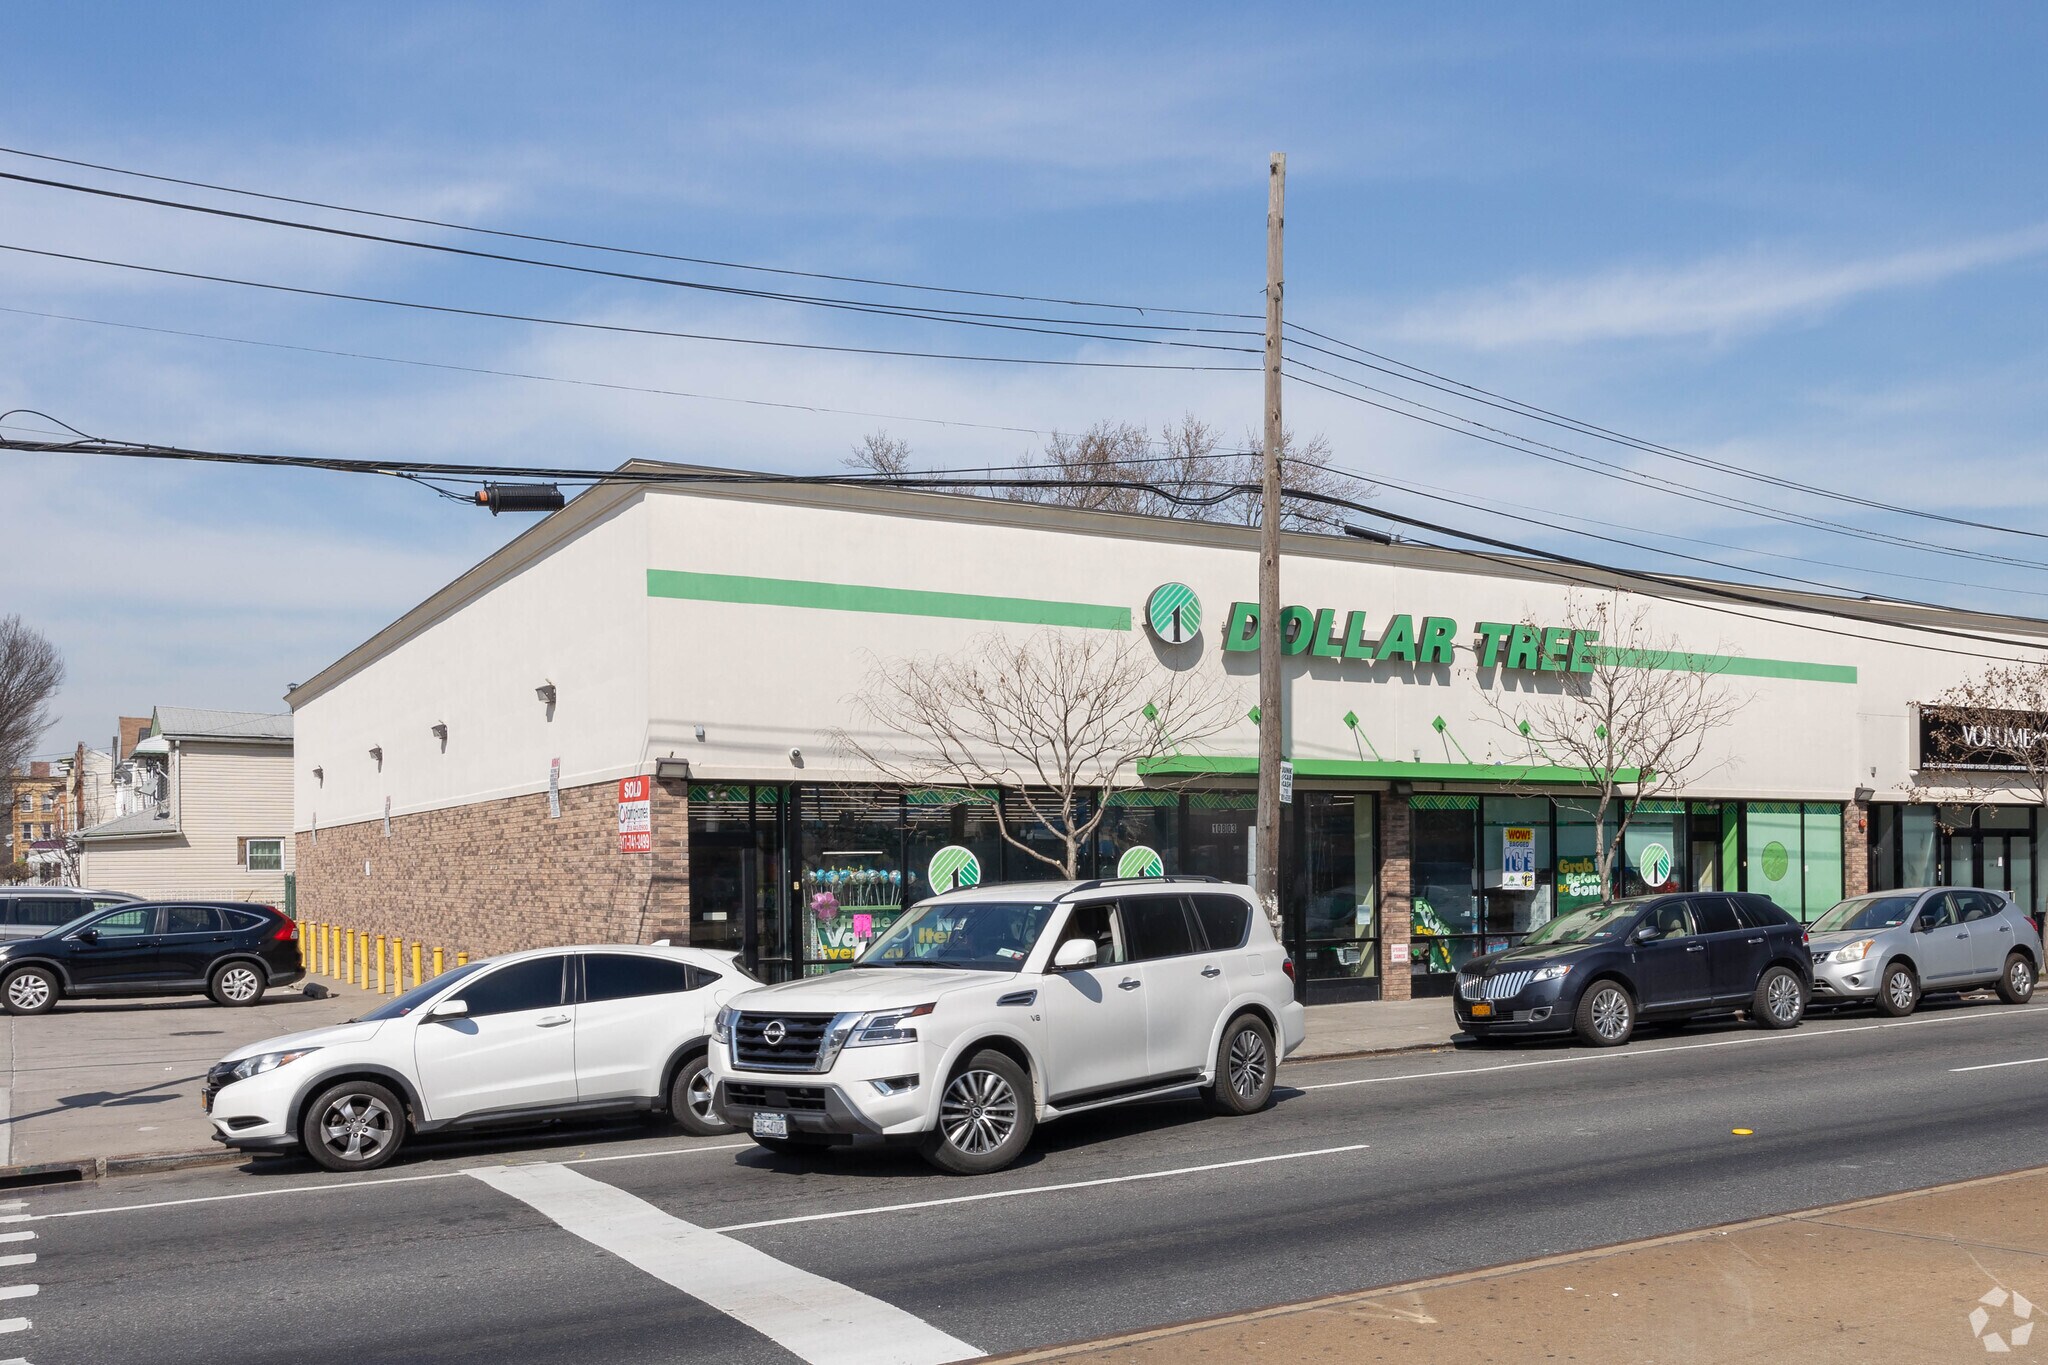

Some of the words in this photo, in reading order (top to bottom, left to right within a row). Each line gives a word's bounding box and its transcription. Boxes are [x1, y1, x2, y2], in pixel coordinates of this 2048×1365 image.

[1224, 600, 1457, 664] DOLLAR
[1476, 621, 1600, 674] TREE
[1962, 725, 2032, 748] VOLUME
[624, 781, 642, 798] SOLD
[1508, 829, 1531, 840] WOW!
[1504, 848, 1534, 872] ICE
[1559, 858, 1594, 873] Grab
[1566, 873, 1602, 885] Befor
[1030, 1014, 1041, 1022] V8
